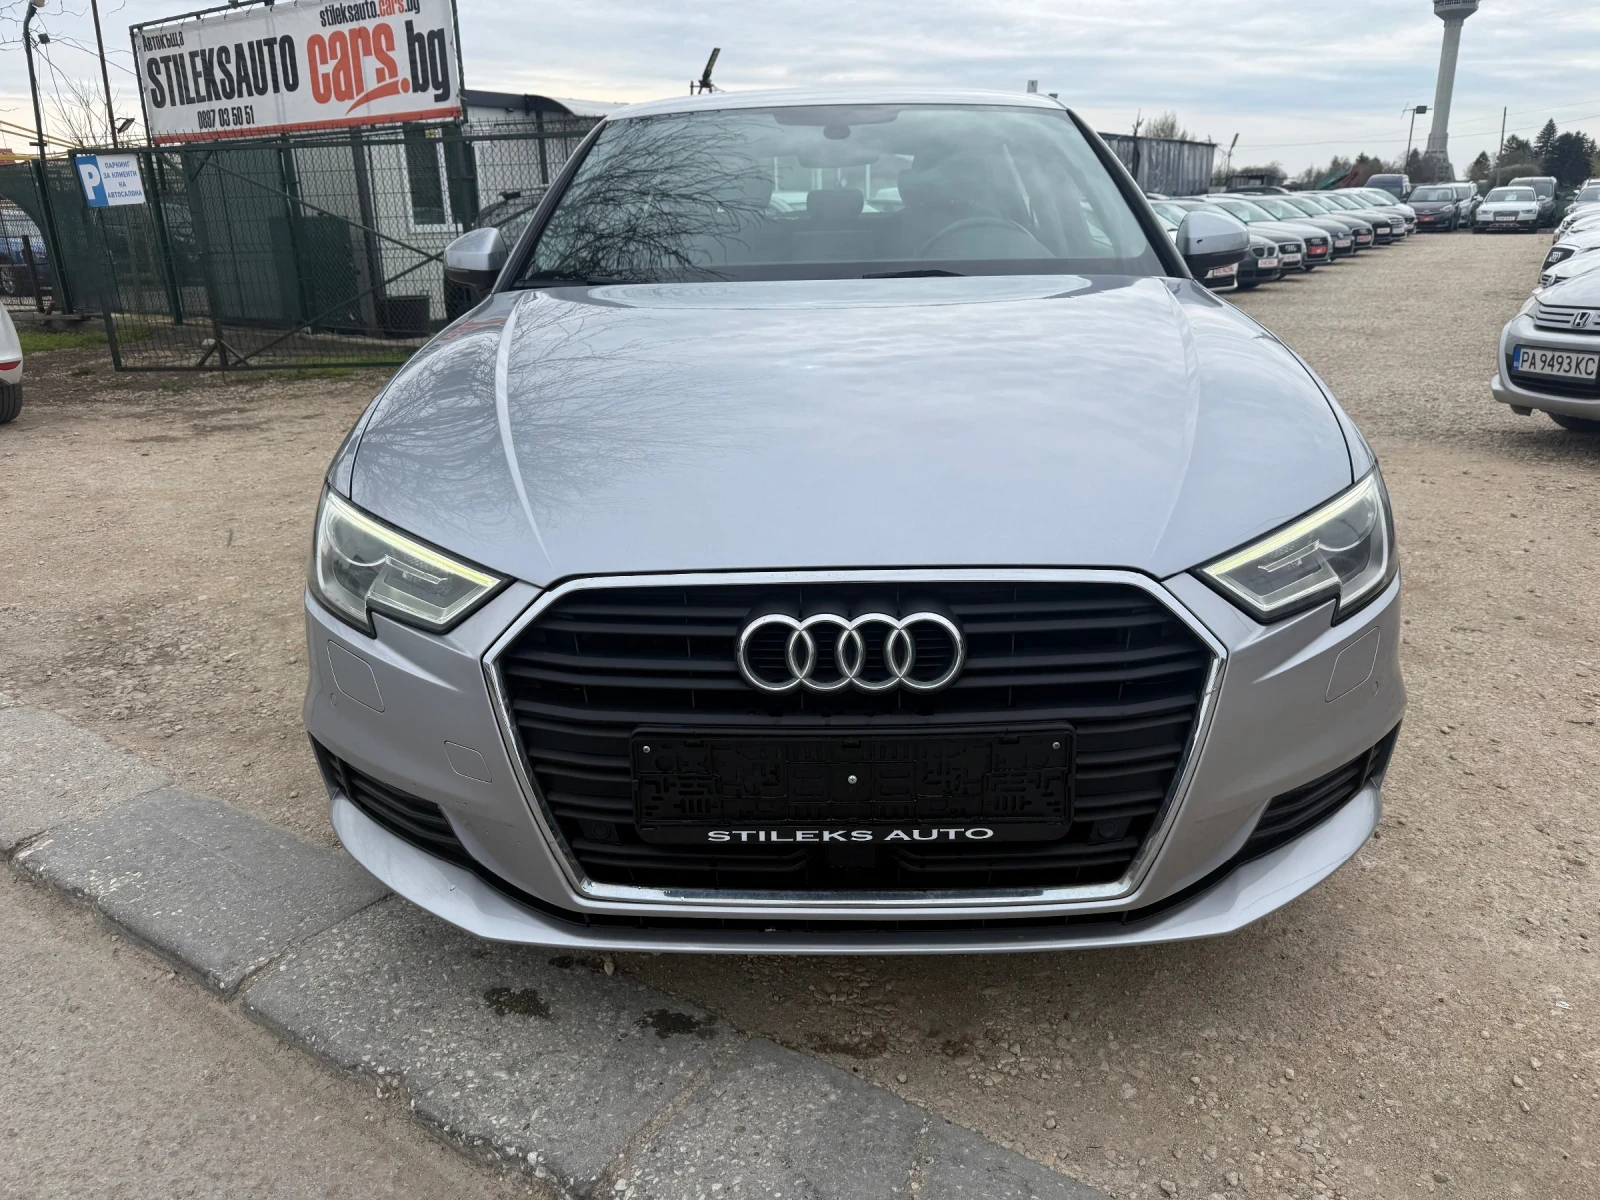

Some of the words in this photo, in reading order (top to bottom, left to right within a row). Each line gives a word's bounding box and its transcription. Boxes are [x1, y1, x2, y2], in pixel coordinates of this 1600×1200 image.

[142, 31, 185, 53] Автокъща
[306, 19, 451, 104] cars.bg
[146, 34, 300, 109] STILEKSAUTO
[197, 109, 216, 130] 0897
[218, 107, 231, 127] 03
[231, 106, 244, 126] 50
[245, 104, 255, 125] 51
[104, 160, 131, 169] ПАРКИНГ
[111, 170, 138, 178] КЛИЕНТИ
[118, 180, 127, 188] НА
[107, 189, 143, 199] АВТОСАЛОНА
[1521, 352, 1536, 370] PA
[1540, 353, 1572, 373] 9493
[1574, 356, 1595, 375] KC
[707, 830, 873, 842] STILEKS
[884, 827, 994, 841] AUTO
